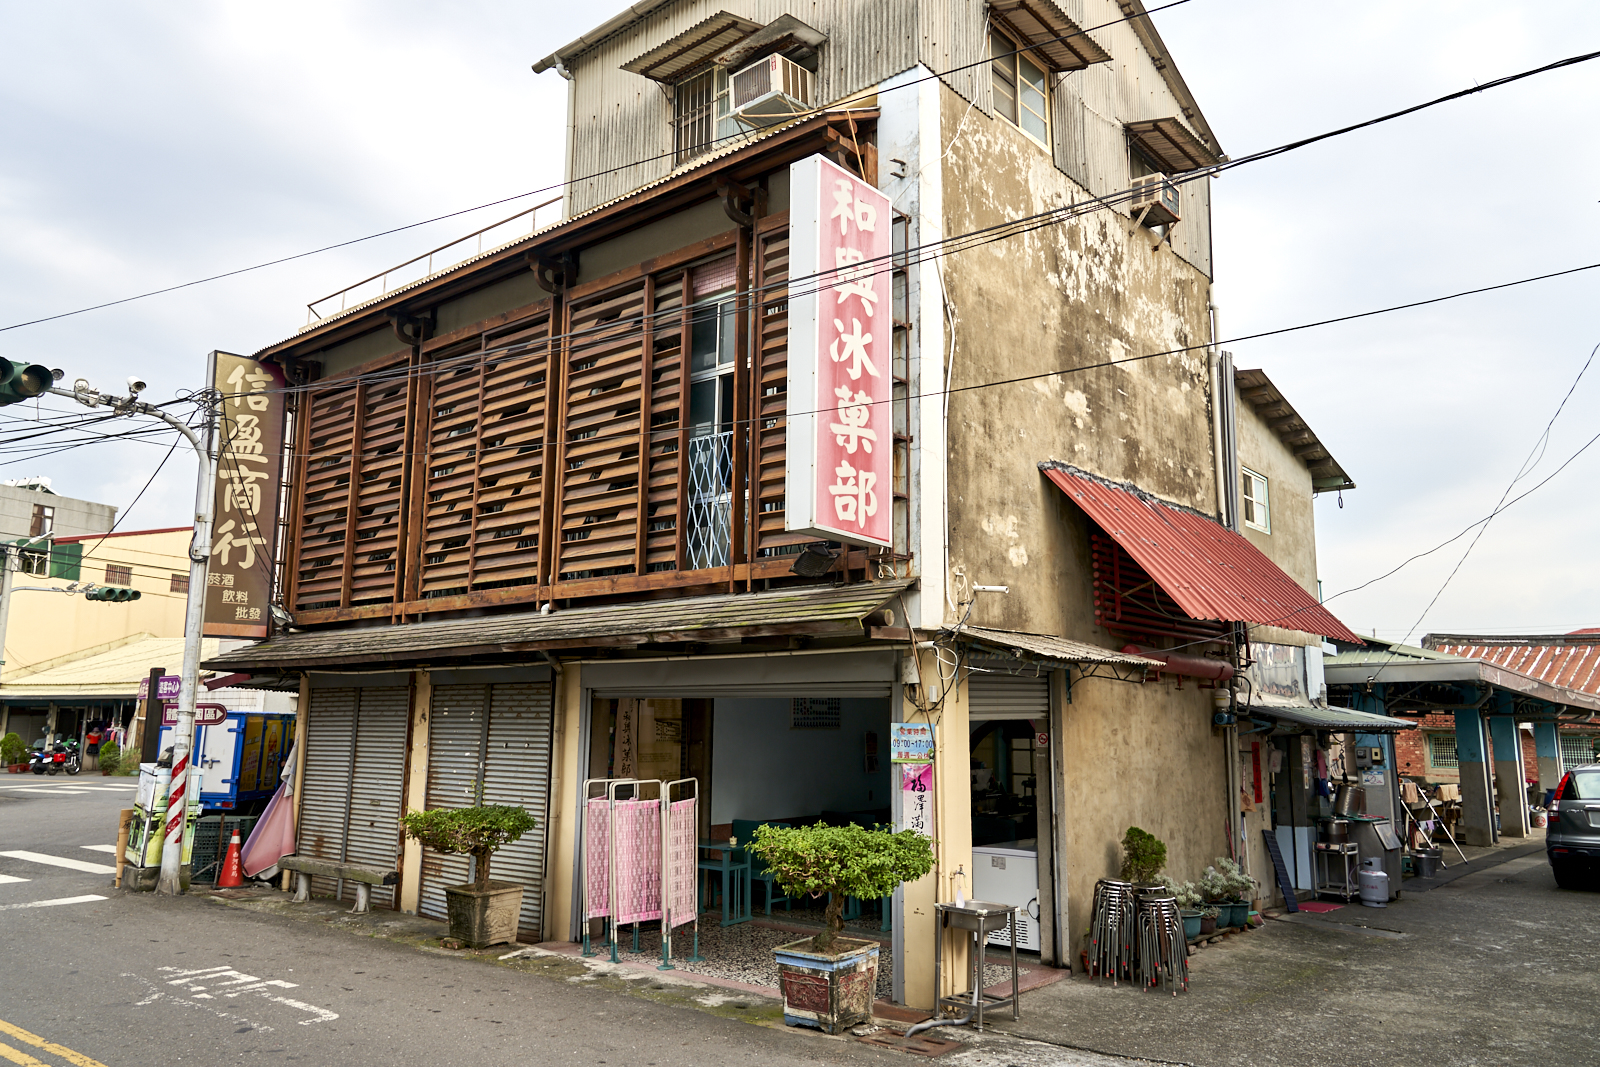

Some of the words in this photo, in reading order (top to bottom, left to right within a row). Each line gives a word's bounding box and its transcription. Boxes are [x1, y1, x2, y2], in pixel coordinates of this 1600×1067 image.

[828, 177, 882, 530] 和興冰菓部
[212, 364, 275, 570] 信盈商行
[208, 572, 235, 586] 菸酒
[222, 589, 249, 603] 飲料
[235, 606, 262, 620] 批發
